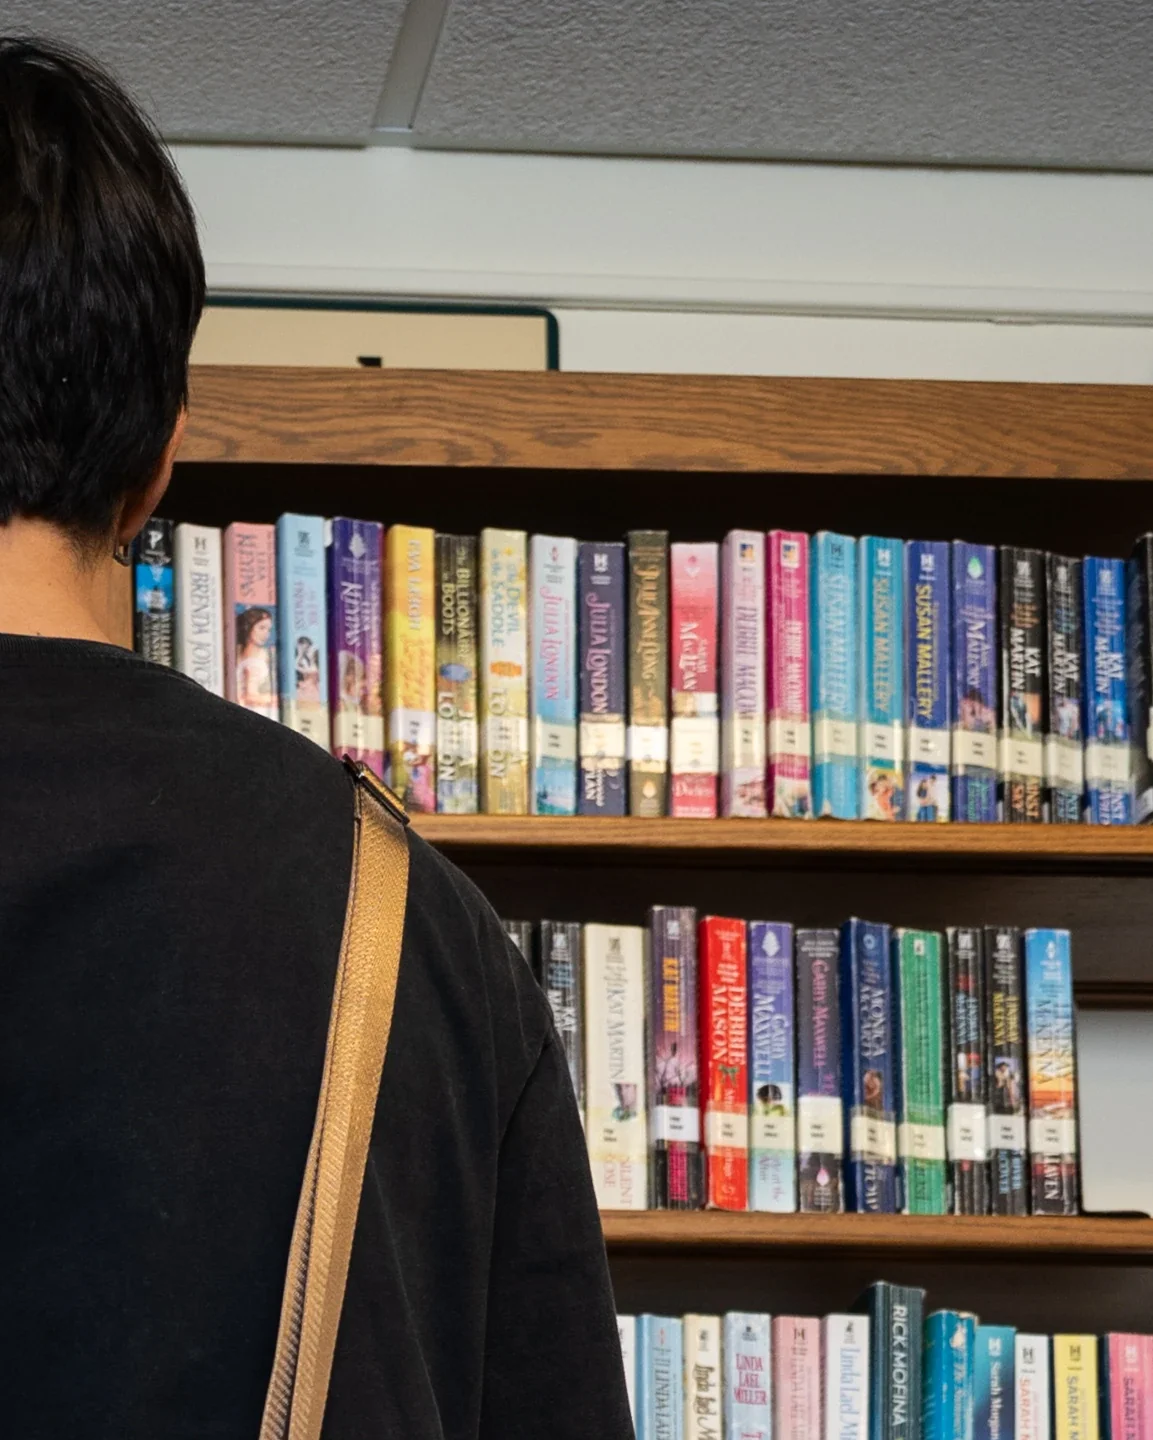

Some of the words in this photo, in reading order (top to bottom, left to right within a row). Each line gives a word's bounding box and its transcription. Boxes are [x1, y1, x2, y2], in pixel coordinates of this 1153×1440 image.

[191, 571, 214, 634] BRENDA
[441, 582, 456, 635] BOOTS
[539, 586, 562, 634] JULIA
[585, 592, 610, 645] JULIA
[874, 577, 890, 632] SUSAN
[916, 584, 930, 640] SUSAN
[542, 638, 564, 701] LONDON
[585, 648, 612, 713] LONDON
[875, 638, 891, 712] MALLERY
[916, 644, 932, 719] MALLERY
[1010, 628, 1026, 690] MARTIN
[1026, 646, 1040, 676] KAT
[1052, 632, 1065, 693] MARTIN
[1064, 653, 1079, 681] KAT
[1095, 636, 1109, 693] MARTIN
[1109, 653, 1123, 681] KAT
[562, 1007, 575, 1032] KAT
[607, 988, 626, 1016] KAT
[712, 983, 727, 1061] MASON
[728, 986, 745, 1065] DEBBIE
[871, 988, 887, 1056] MONICA
[607, 1020, 628, 1079] MARTIN
[753, 992, 773, 1078] MAXWELL
[893, 1306, 907, 1350] RICK
[655, 1369, 669, 1410] LINDA
[841, 1347, 860, 1384] Linda
[893, 1353, 907, 1425] MOFINA
[990, 1361, 1001, 1395] Sarah
[988, 1399, 1000, 1440] Morgan
[1067, 1376, 1078, 1428] SARAH
[1123, 1377, 1134, 1430] SARAH
